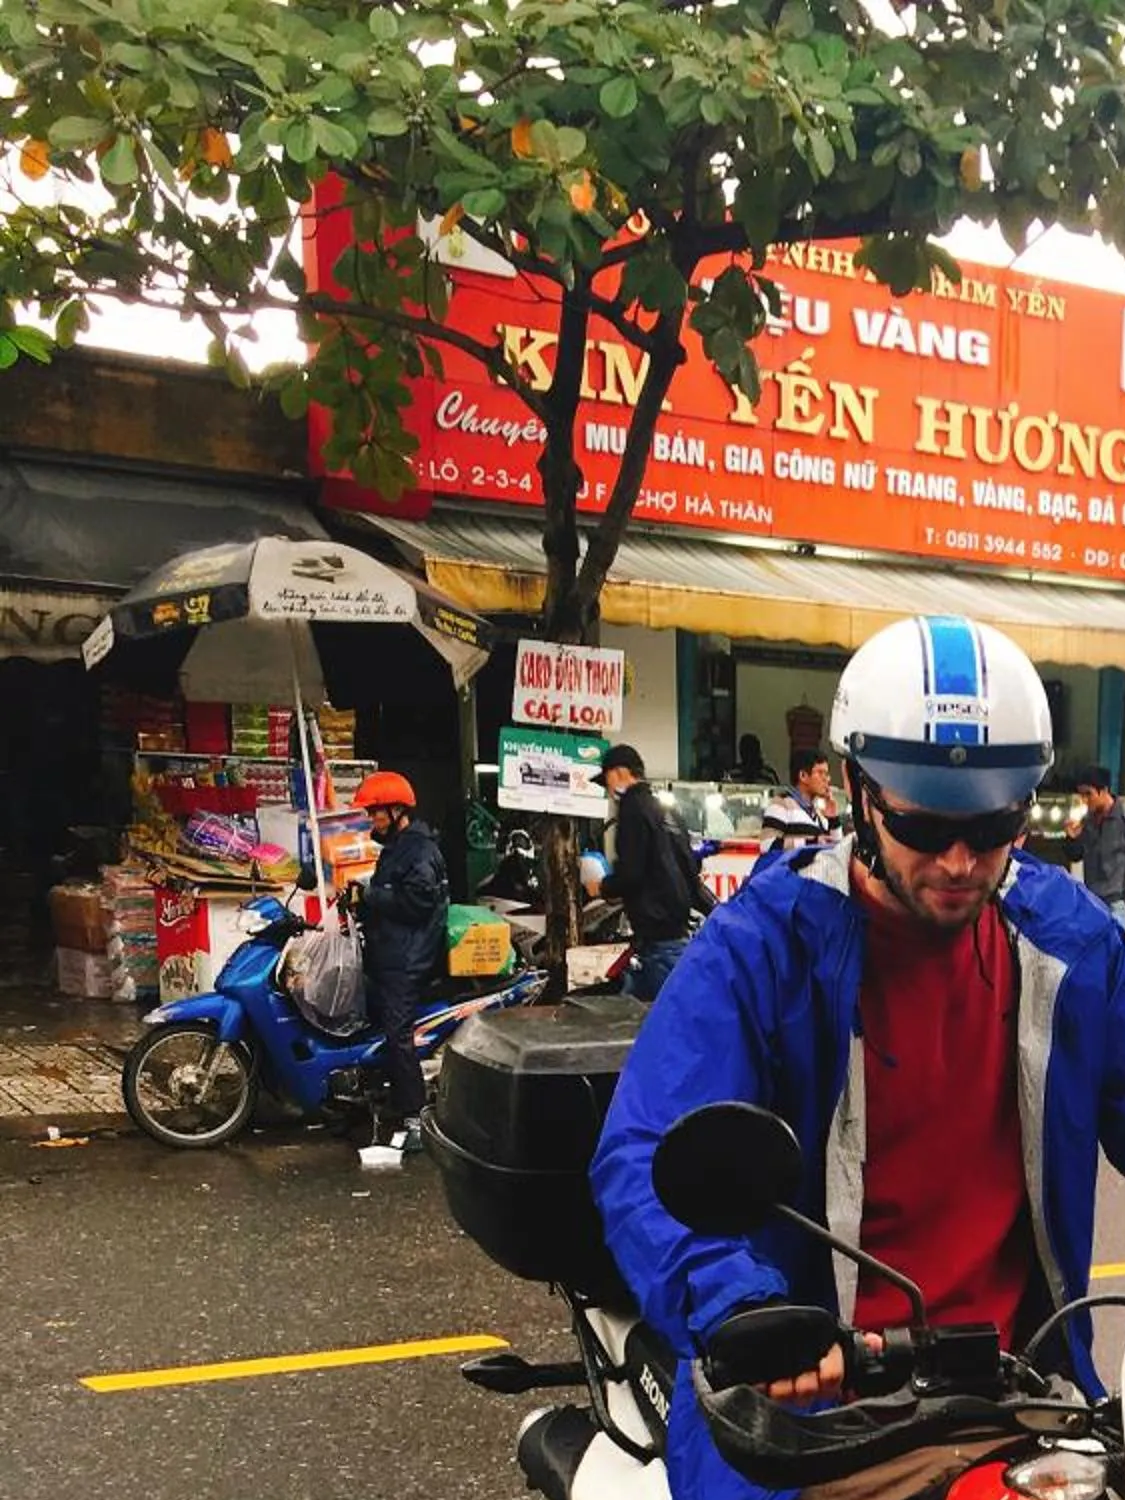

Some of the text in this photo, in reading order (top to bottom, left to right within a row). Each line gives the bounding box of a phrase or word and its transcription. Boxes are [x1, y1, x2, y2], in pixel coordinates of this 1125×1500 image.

[852, 305, 990, 367] VÀNG
[586, 423, 628, 455] MU
[725, 444, 765, 477] GIA
[774, 451, 835, 486] CÔNG
[844, 460, 878, 491] NỮ
[471, 466, 532, 493] 2-3-4
[686, 487, 715, 517] HÀ
[946, 529, 980, 550] 0511
[984, 534, 1025, 556] 3944
[520, 651, 550, 689] CARD
[640, 1363, 672, 1428] HON
